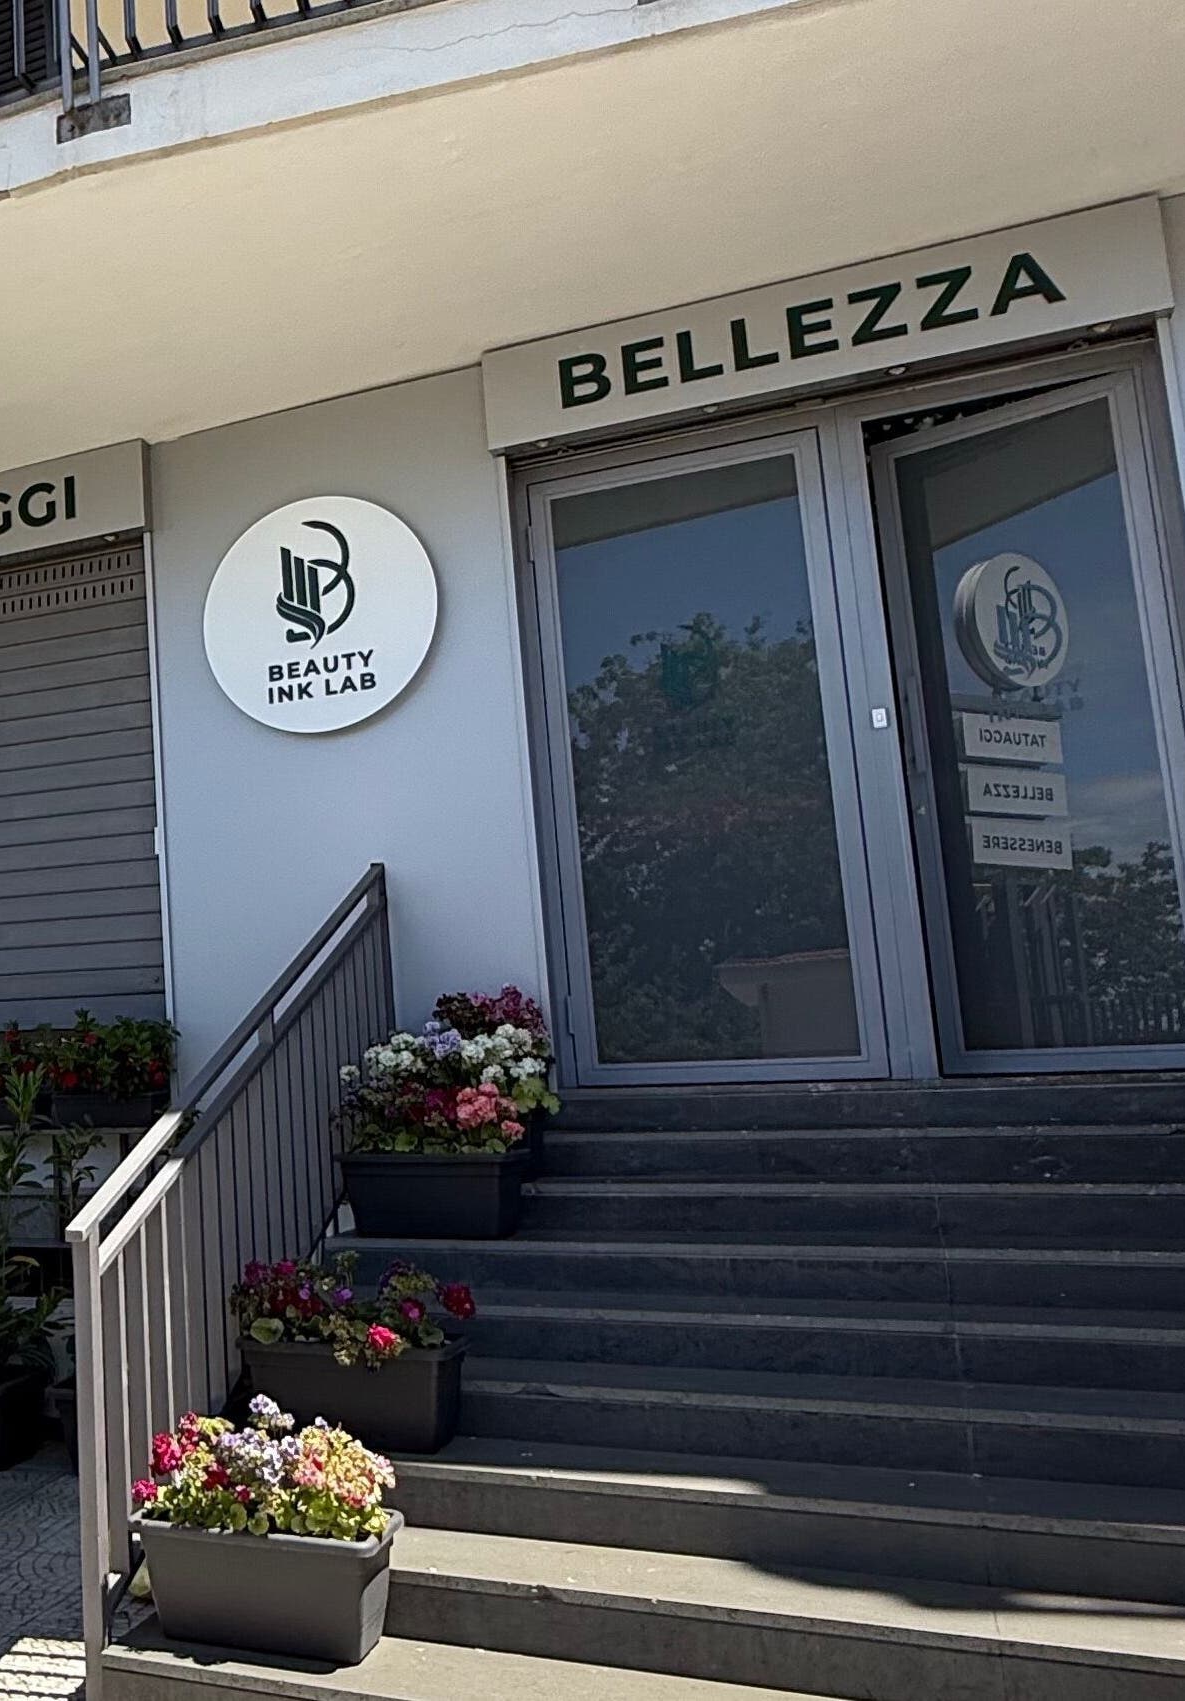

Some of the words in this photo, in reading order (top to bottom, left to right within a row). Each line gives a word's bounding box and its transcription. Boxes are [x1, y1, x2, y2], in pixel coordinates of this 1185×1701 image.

[558, 252, 1067, 409] BELLEZZA
[268, 648, 374, 682] BEAUTY
[268, 681, 314, 705] INK
[325, 672, 376, 696] LAB
